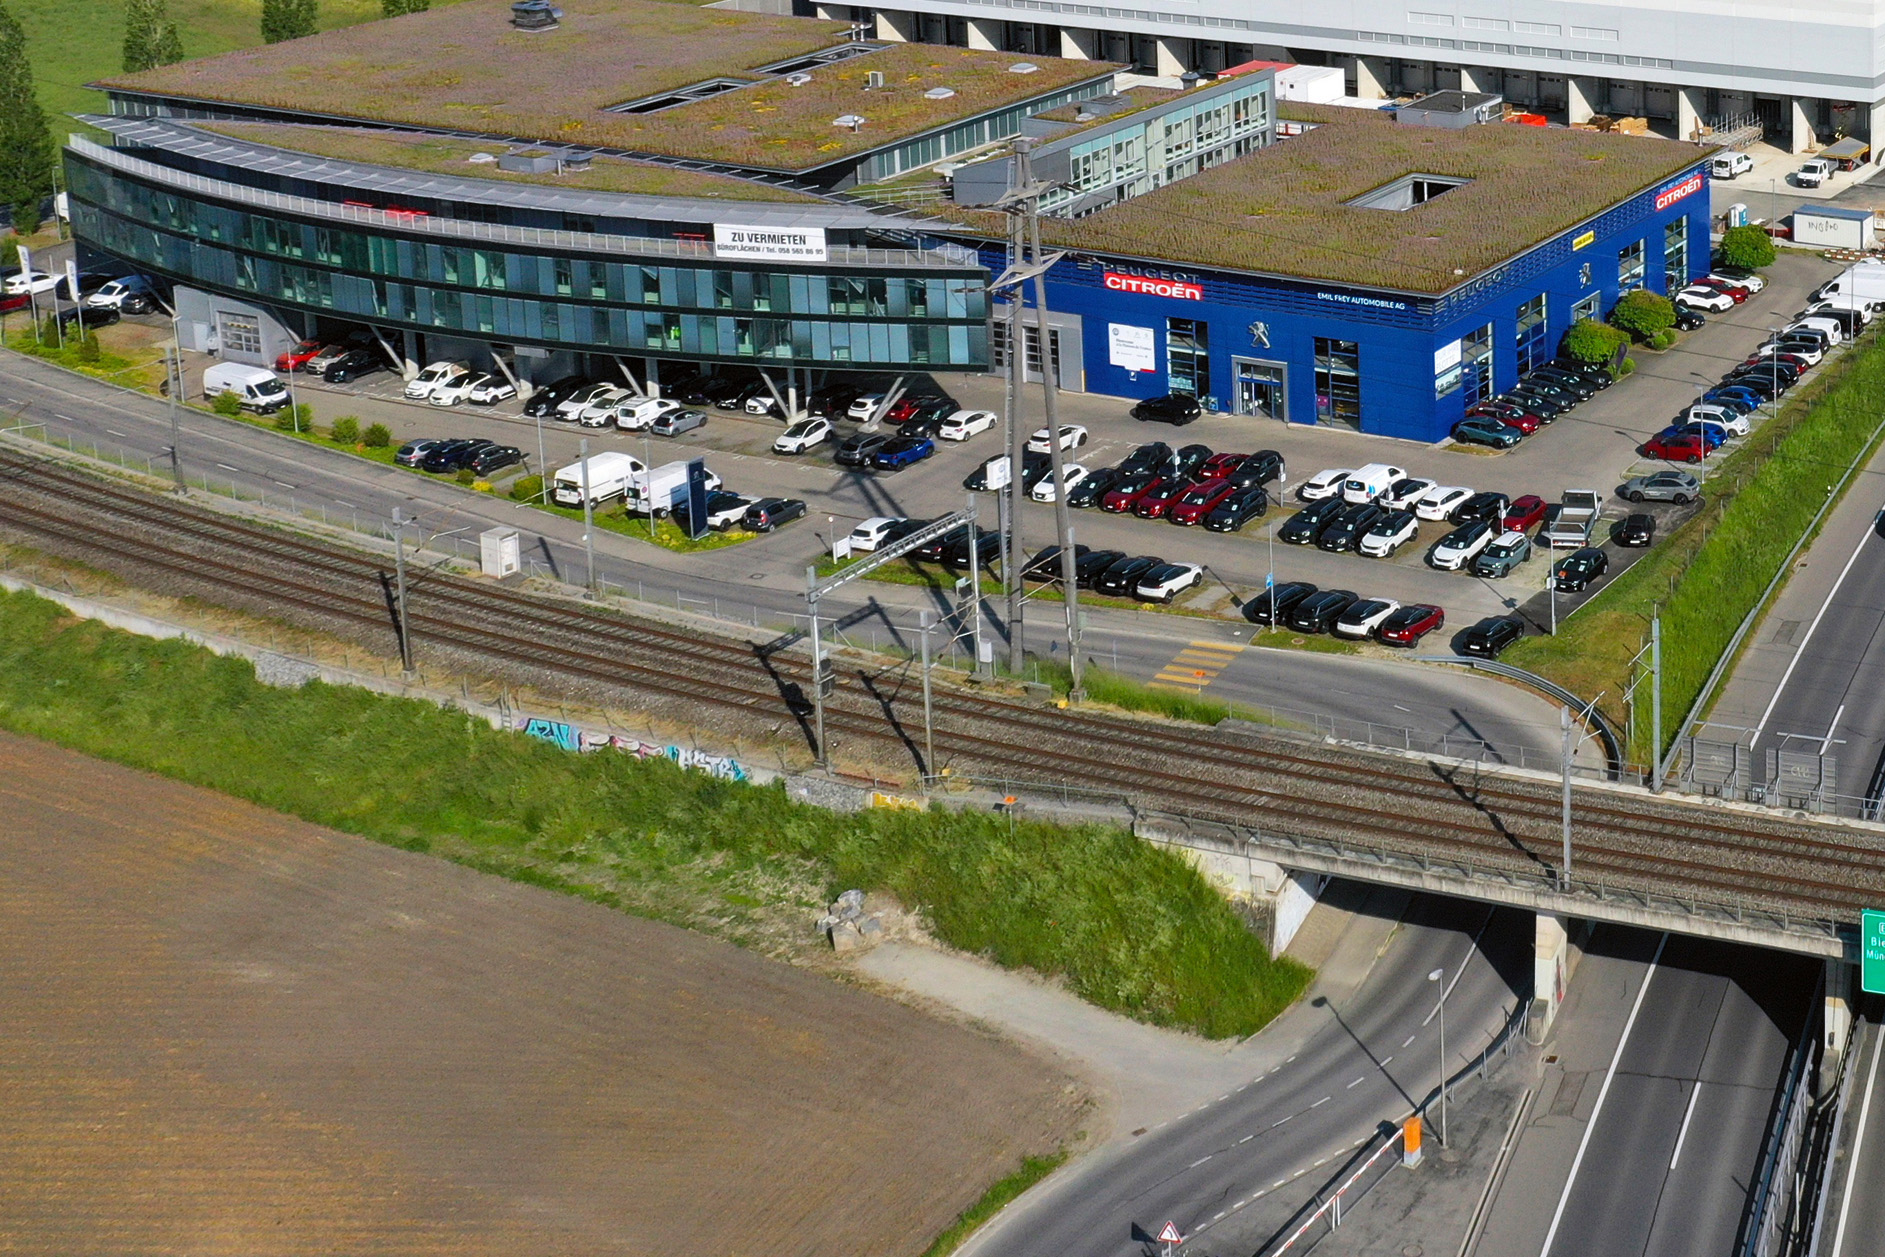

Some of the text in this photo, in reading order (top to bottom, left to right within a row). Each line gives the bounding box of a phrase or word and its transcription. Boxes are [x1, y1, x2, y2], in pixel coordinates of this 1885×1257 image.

[731, 232, 806, 245] ZU VERMIETEN
[1102, 263, 1200, 284] PEUGEOT
[1106, 276, 1200, 300] CITROËN
[1317, 292, 1405, 310] EMIL FREY AUTOMOBILE AG
